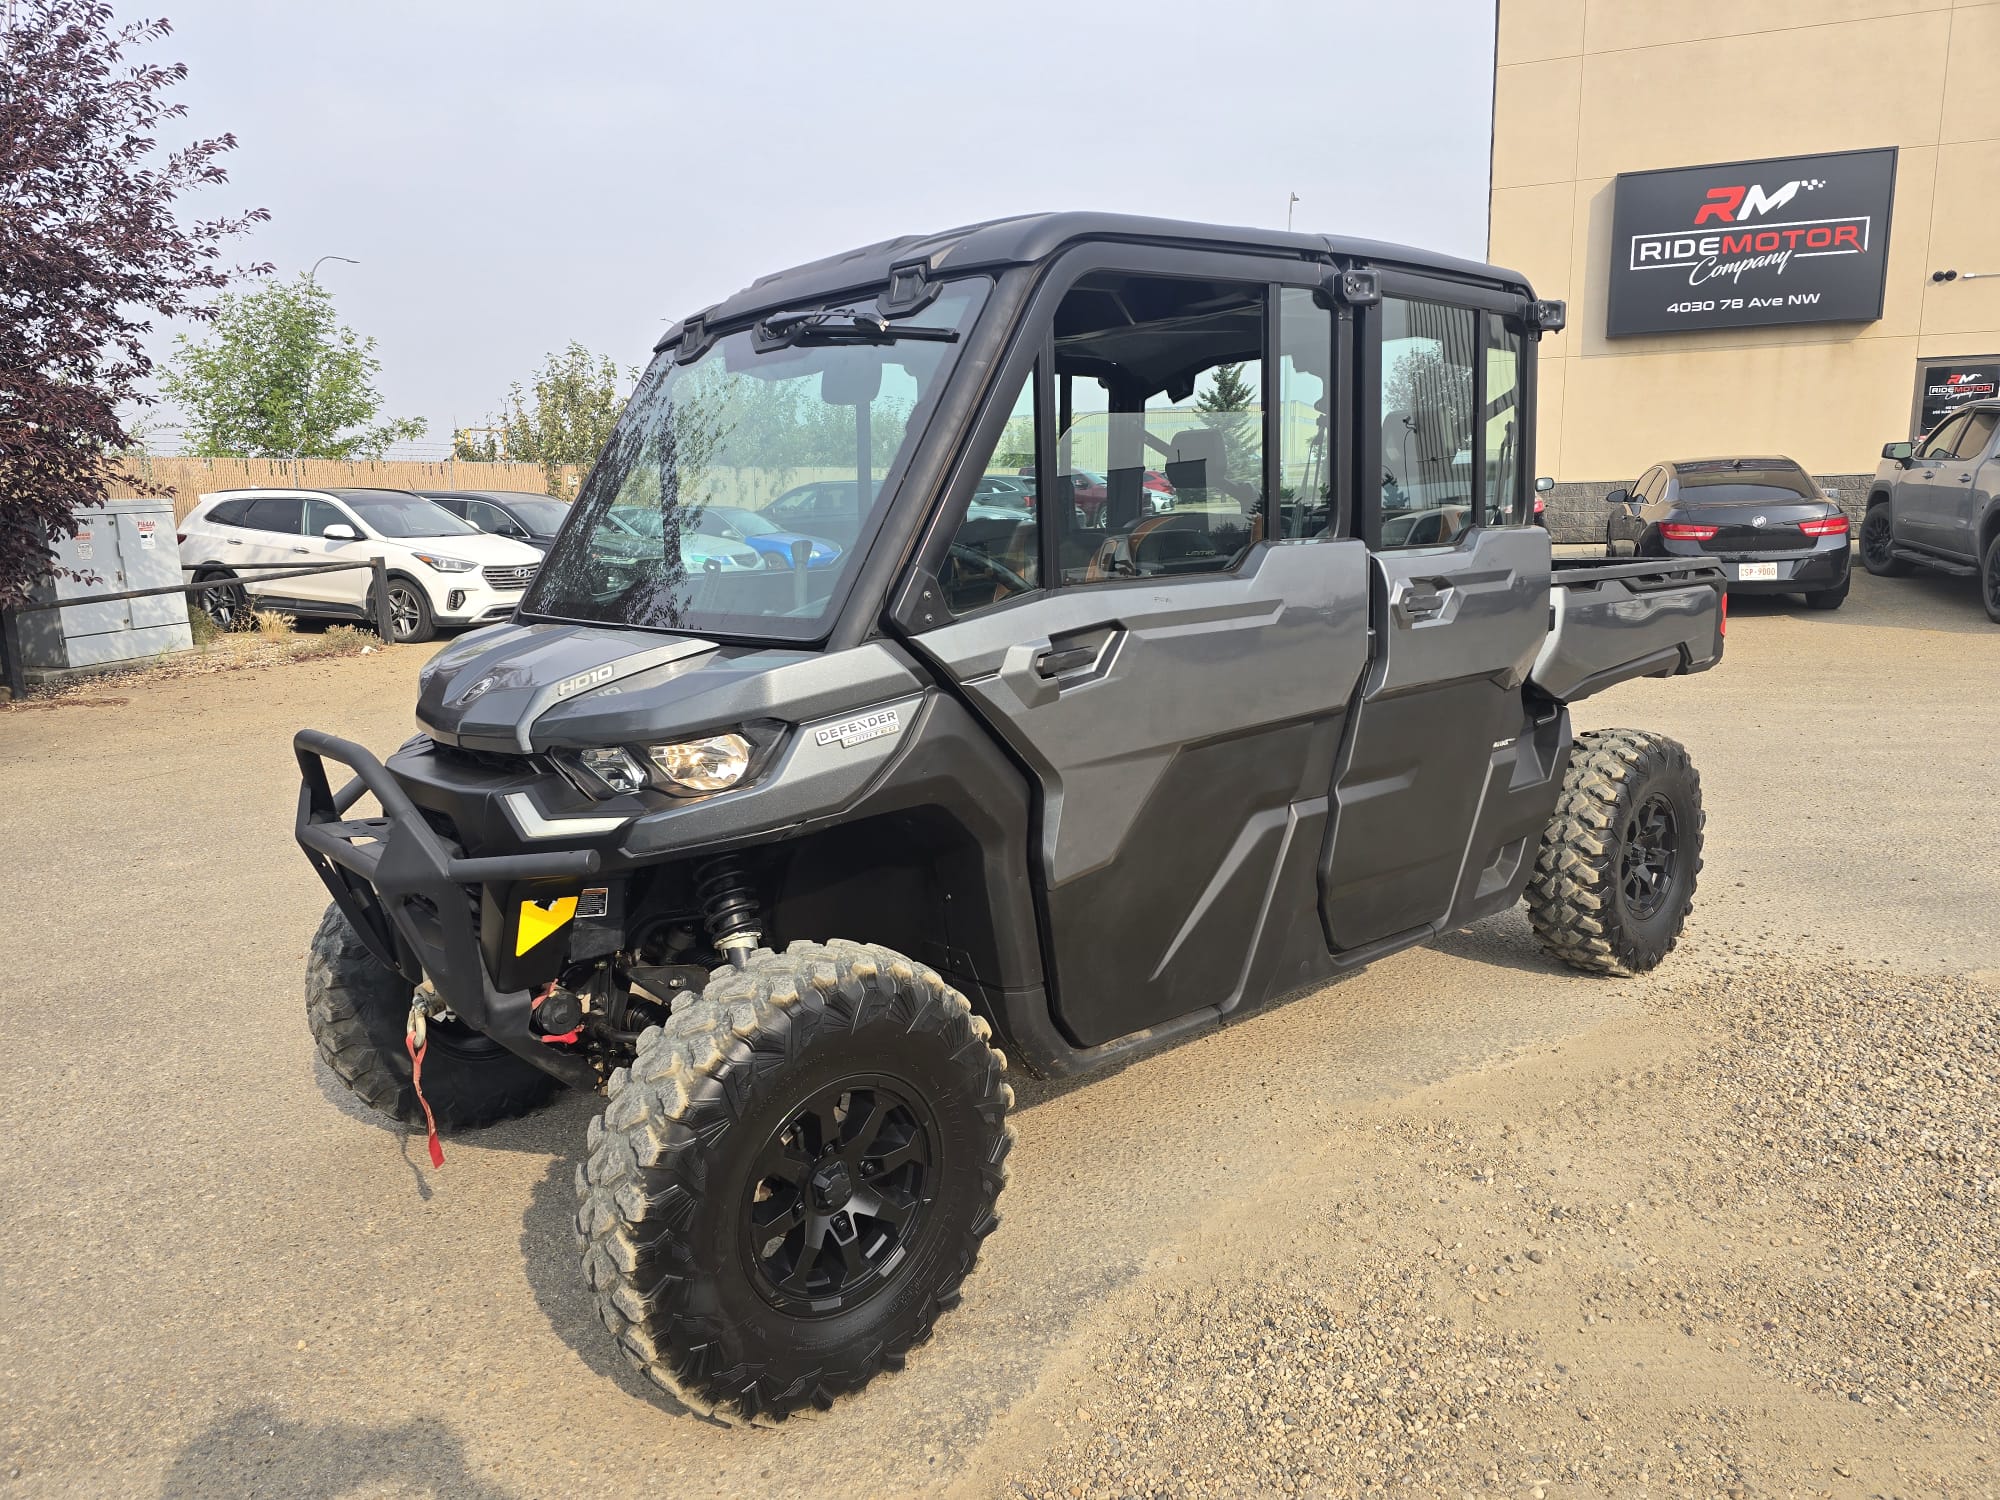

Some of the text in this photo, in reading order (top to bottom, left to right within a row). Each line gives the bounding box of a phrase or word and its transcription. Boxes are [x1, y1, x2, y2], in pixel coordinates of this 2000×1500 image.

[1694, 181, 1800, 224] RM
[1689, 250, 1791, 285] Company
[1667, 293, 1820, 313] 4030 78 Ave NW
[559, 665, 613, 695] HD10
[819, 711, 896, 742] DEFENDER
